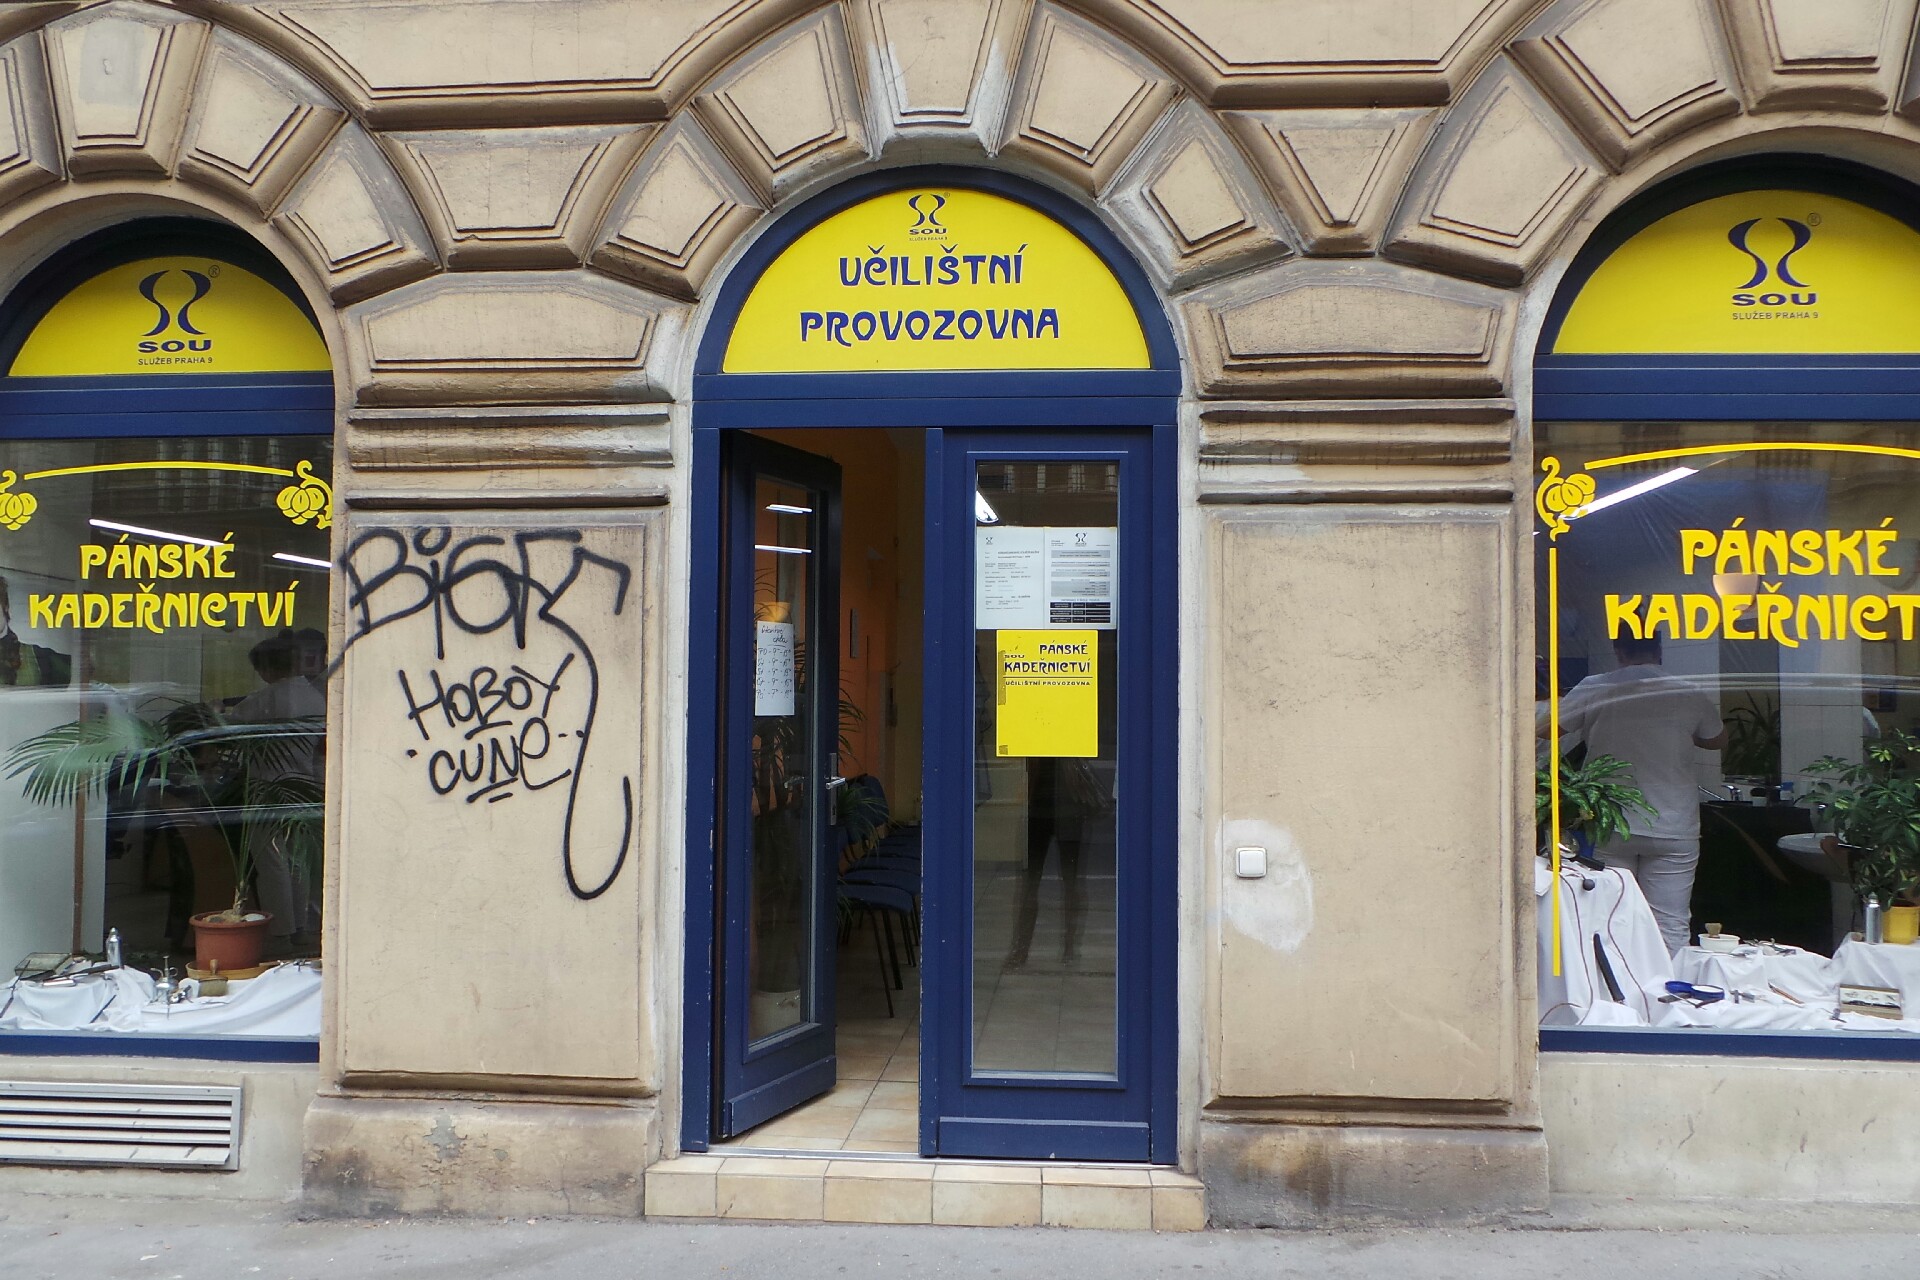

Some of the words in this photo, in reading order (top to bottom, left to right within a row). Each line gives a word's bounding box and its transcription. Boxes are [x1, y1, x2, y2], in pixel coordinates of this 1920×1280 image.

[909, 227, 947, 235] SOU
[839, 244, 1028, 286] UČILIŠTNÍ
[1732, 293, 1817, 306] SOU
[1732, 311, 1773, 321] SLUŽEB
[1813, 311, 1819, 319] 9
[800, 308, 1059, 347] PROVOZOVNA
[138, 339, 212, 354] SOU
[138, 356, 173, 366] SLUŽEB
[174, 356, 206, 364] PRAHA
[207, 356, 213, 364] 9
[1680, 517, 1900, 576] PÁNSKÉ
[80, 532, 236, 579] PÁNSKÉ
[29, 581, 299, 633] KADEŘNICTVÍ
[1039, 639, 1088, 655] PÁNSKÉ
[1004, 657, 1090, 675] KADEŘNICTVÍ
